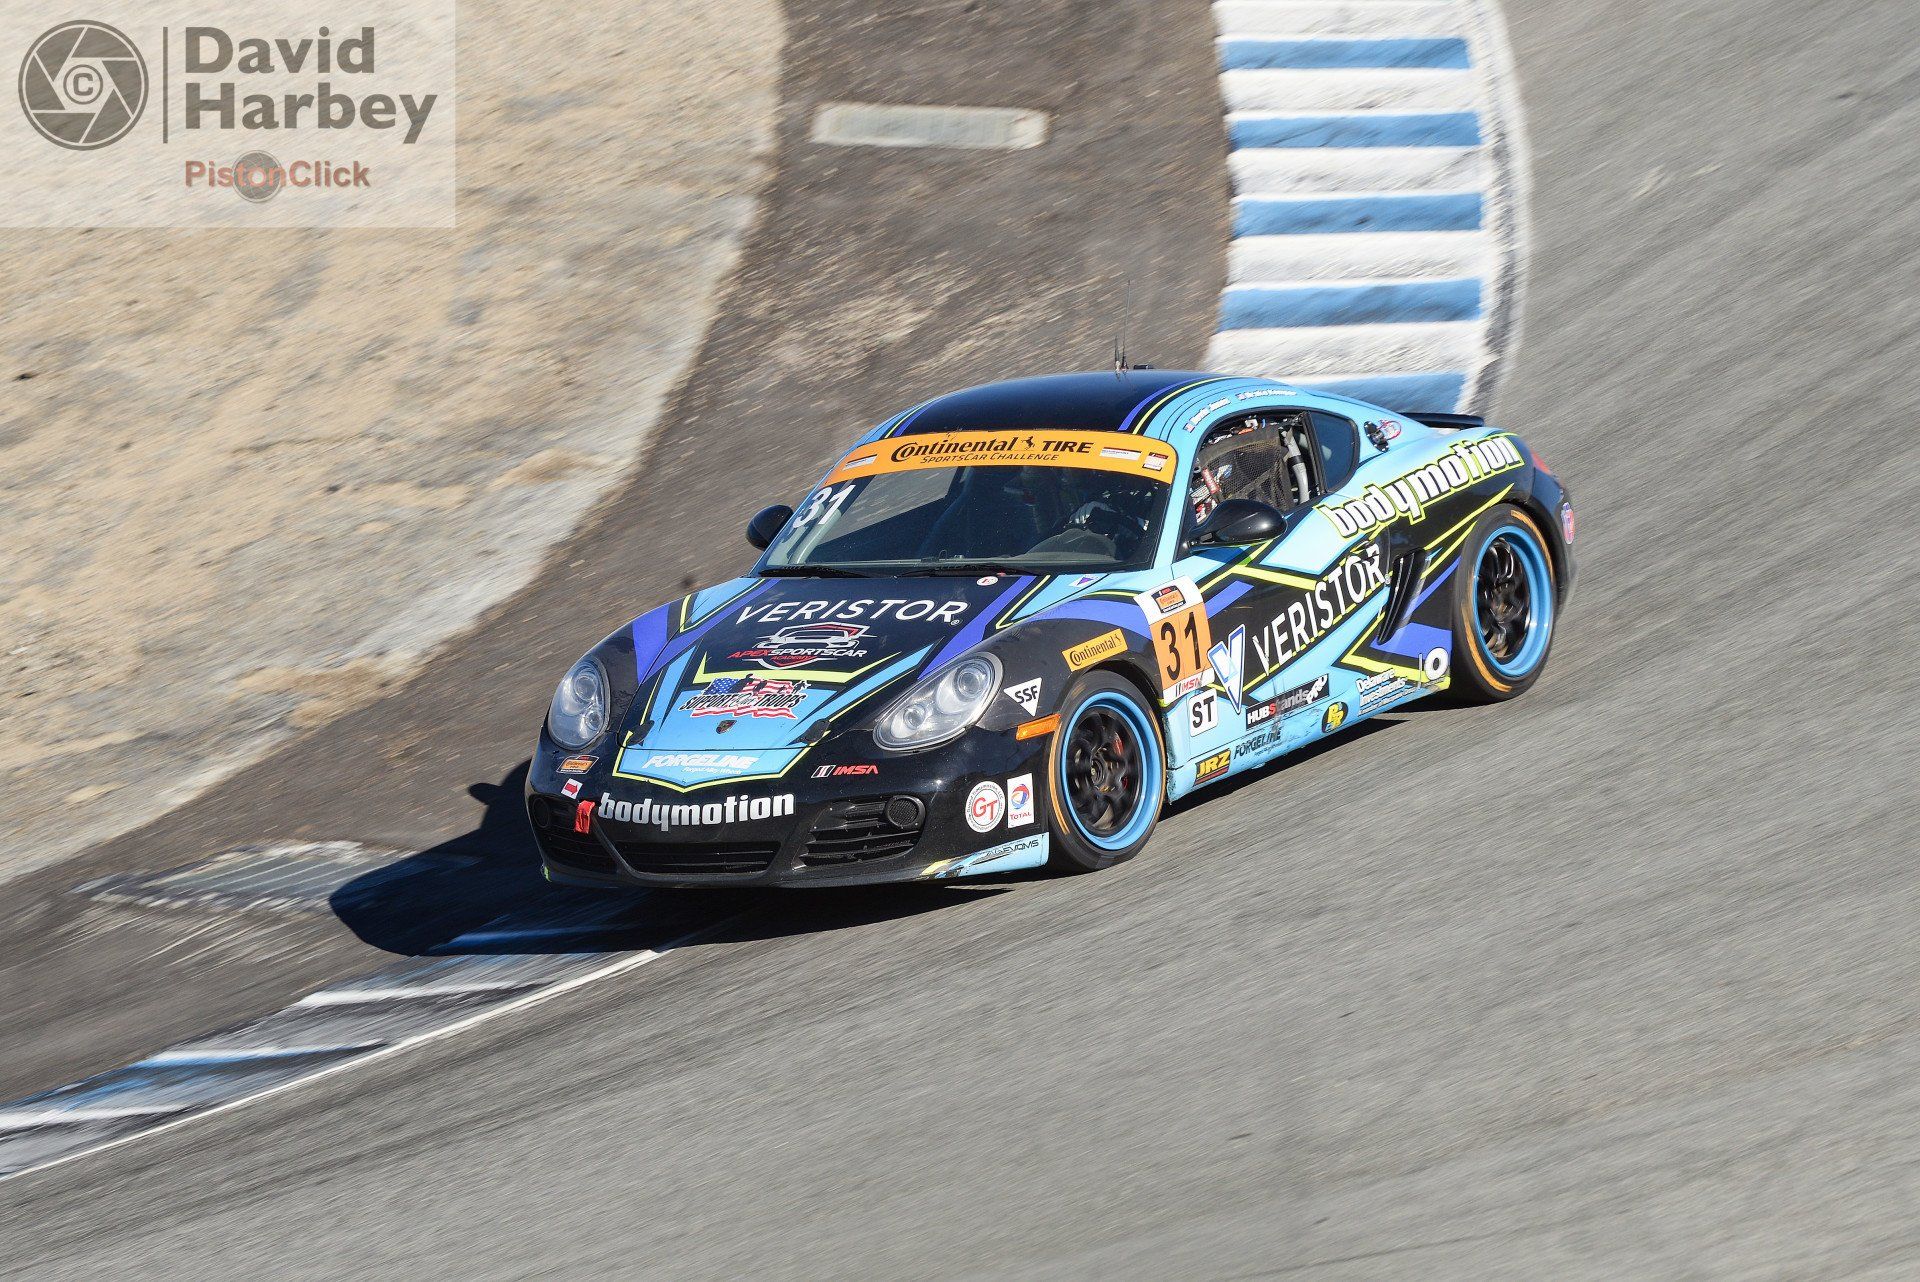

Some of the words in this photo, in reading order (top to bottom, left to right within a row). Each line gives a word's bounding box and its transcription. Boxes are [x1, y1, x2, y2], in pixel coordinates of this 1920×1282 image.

[891, 437, 1019, 462] Continental
[1042, 440, 1094, 453] TIRE
[920, 454, 988, 463] SPORTSCAR
[989, 453, 1059, 461] CHALLENGE
[1319, 436, 1522, 538] bodymotion
[792, 484, 856, 528] 31
[1069, 637, 1117, 666] Continental
[1161, 611, 1201, 681] 31
[1356, 668, 1395, 693] Delaware
[1359, 676, 1408, 707] Investments
[753, 694, 807, 709] TROOPS
[1014, 685, 1038, 704] SSF
[1192, 696, 1215, 728] ST
[642, 754, 759, 770] FORGELINE
[833, 765, 879, 776] IMSA
[1196, 750, 1231, 778] JRZ
[598, 792, 795, 831] bodymotion
[973, 796, 998, 821] GT
[1010, 812, 1032, 821] TOTAL
